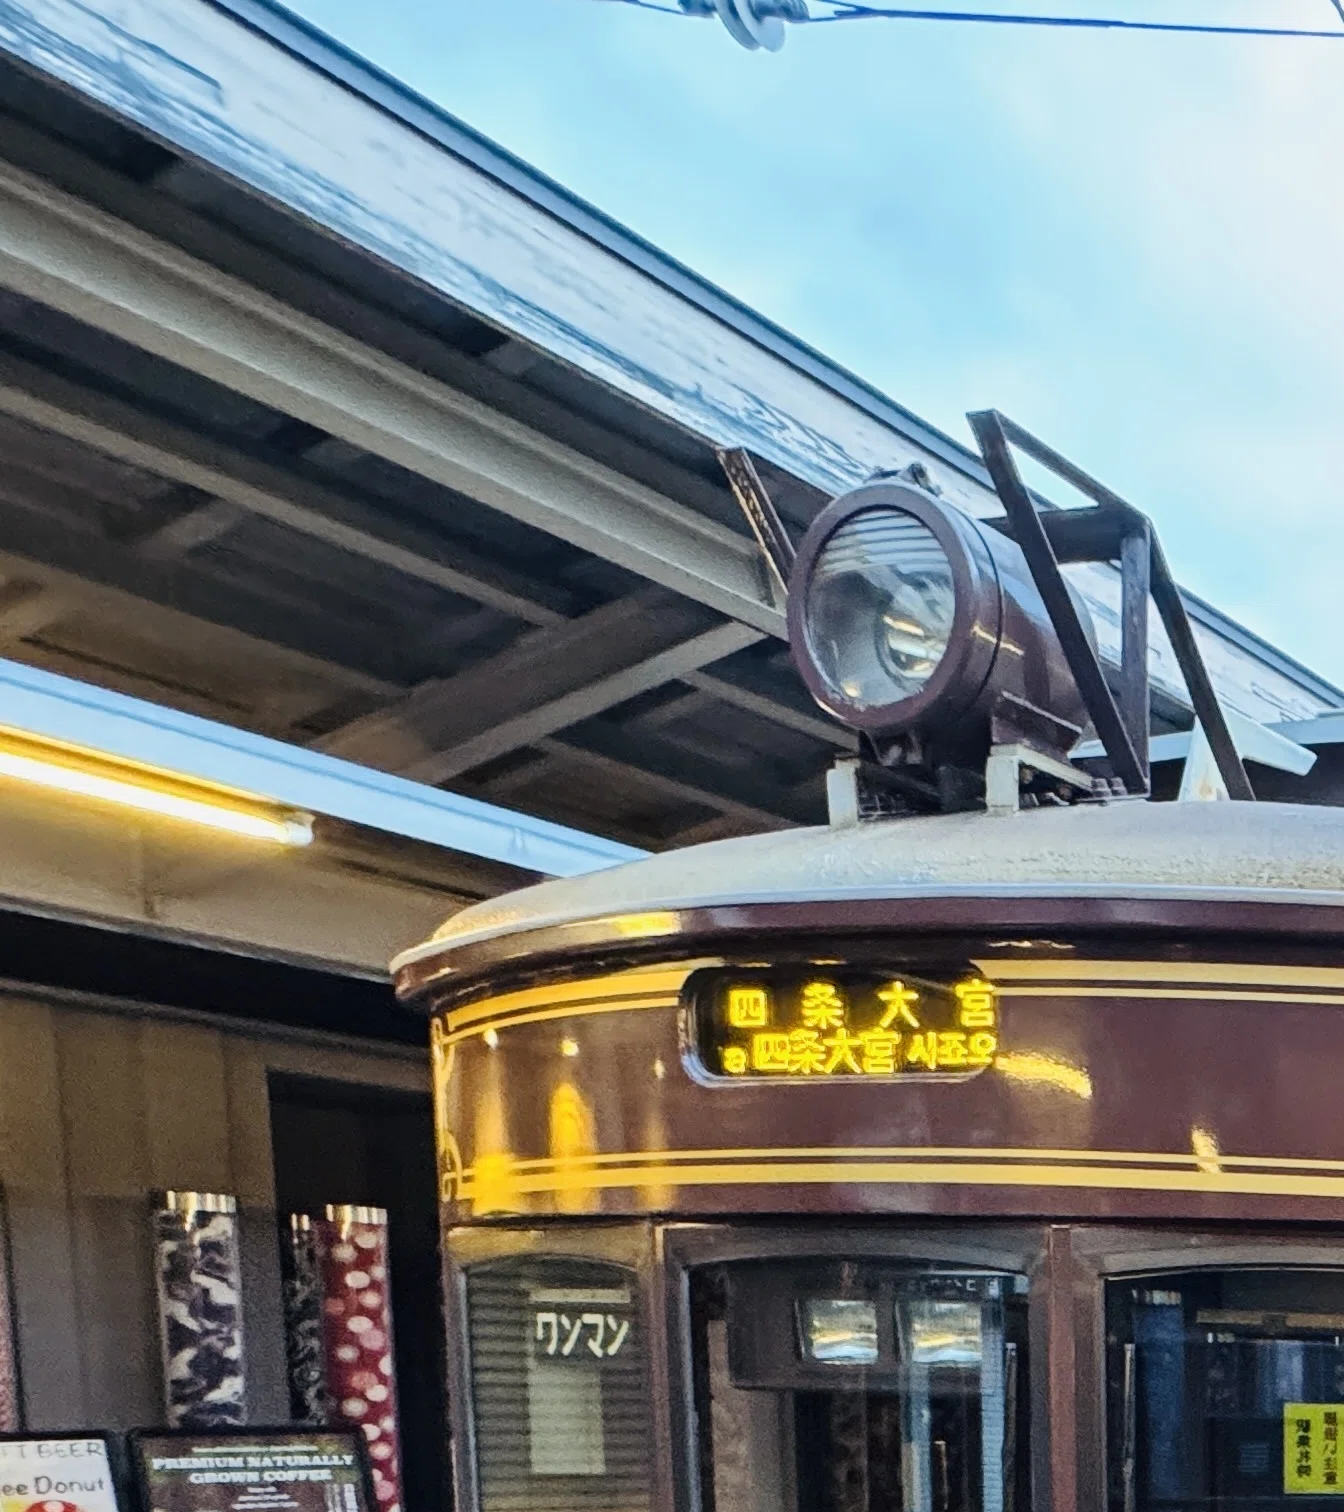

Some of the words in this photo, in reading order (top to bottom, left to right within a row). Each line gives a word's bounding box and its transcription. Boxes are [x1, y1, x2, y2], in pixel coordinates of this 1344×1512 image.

[728, 979, 996, 1030] 四条大宮
[753, 1028, 900, 1075] 四条大宮
[536, 1312, 630, 1358] ワンマン
[152, 1457, 244, 1470] PREMIUM
[247, 1455, 354, 1467] NATURALLY
[189, 1472, 260, 1484] GROWN
[263, 1469, 333, 1482] COFFEE
[34, 1475, 104, 1495] Donut
